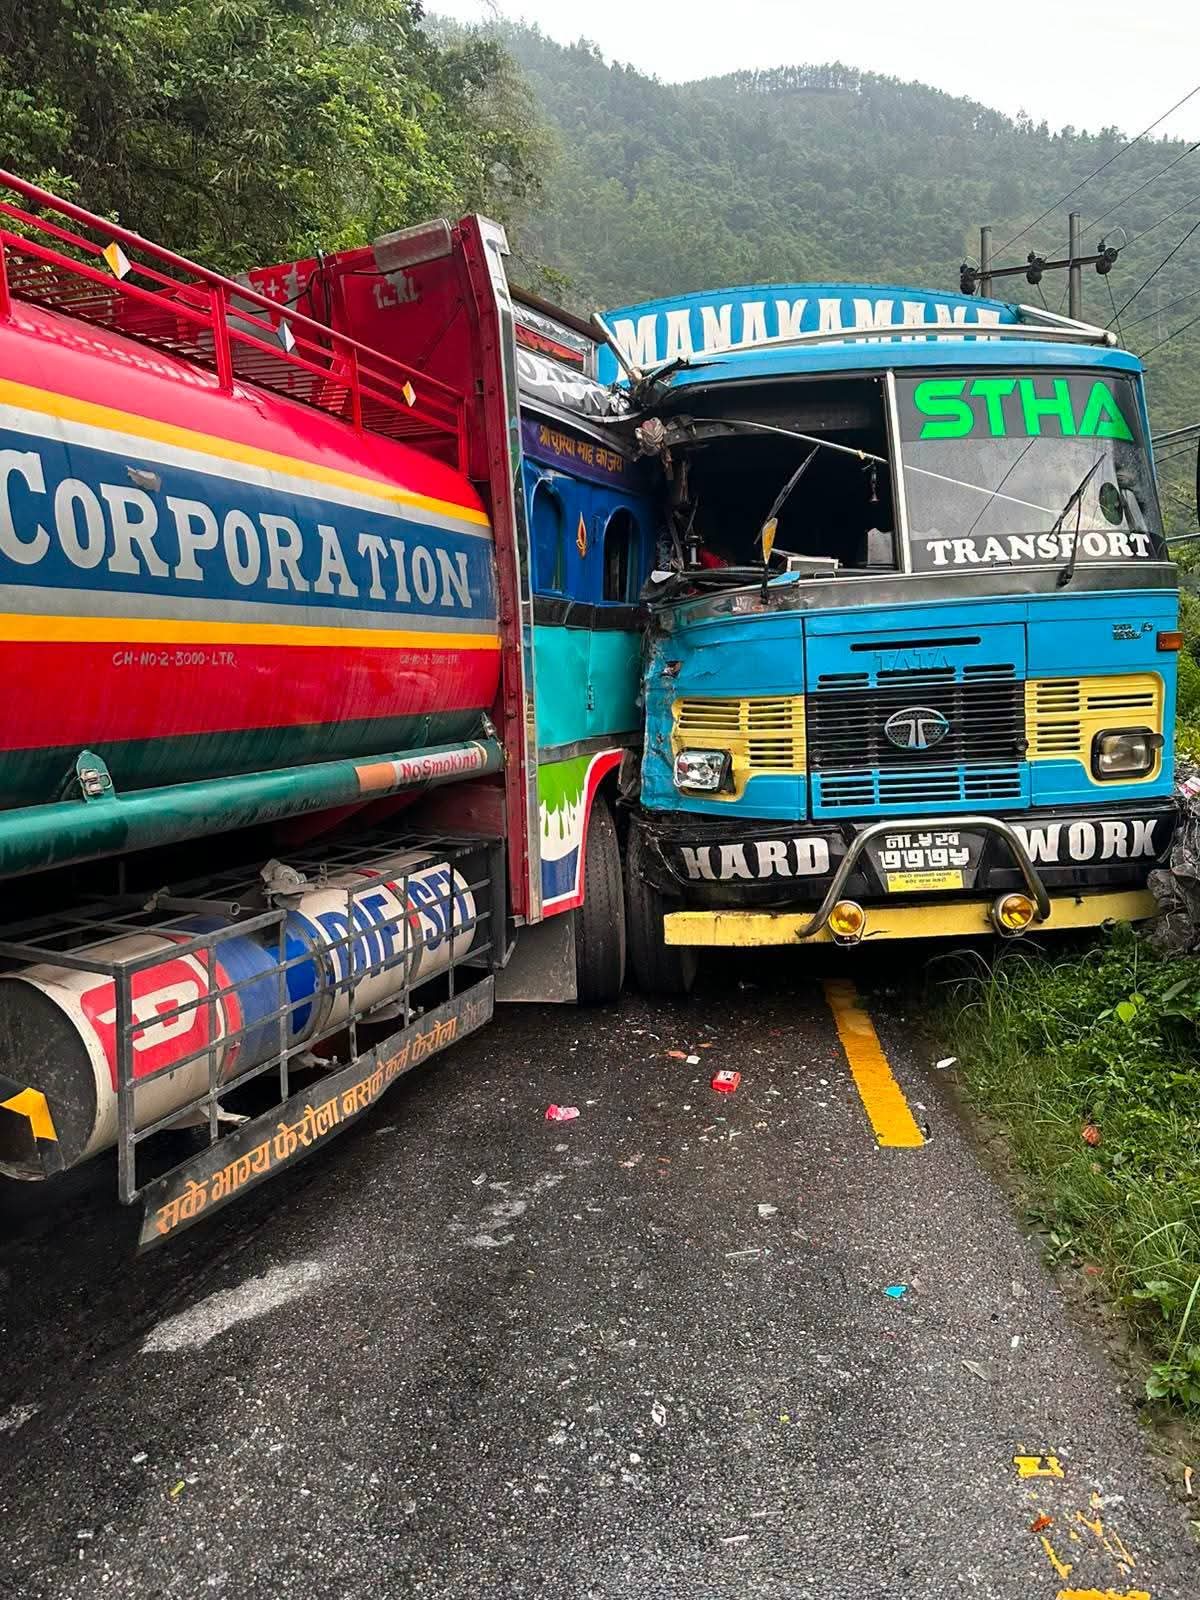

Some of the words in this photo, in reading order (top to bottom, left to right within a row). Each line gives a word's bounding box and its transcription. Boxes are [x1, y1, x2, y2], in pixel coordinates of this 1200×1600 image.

[613, 298, 1001, 380] MANAKAMANA
[914, 378, 1135, 441] STHA
[0, 448, 473, 609] CORPORATION
[926, 532, 1150, 566] TRANSPORT
[680, 837, 831, 880] HARD
[1010, 819, 1158, 863] WORK
[315, 869, 476, 995] DIESEL
